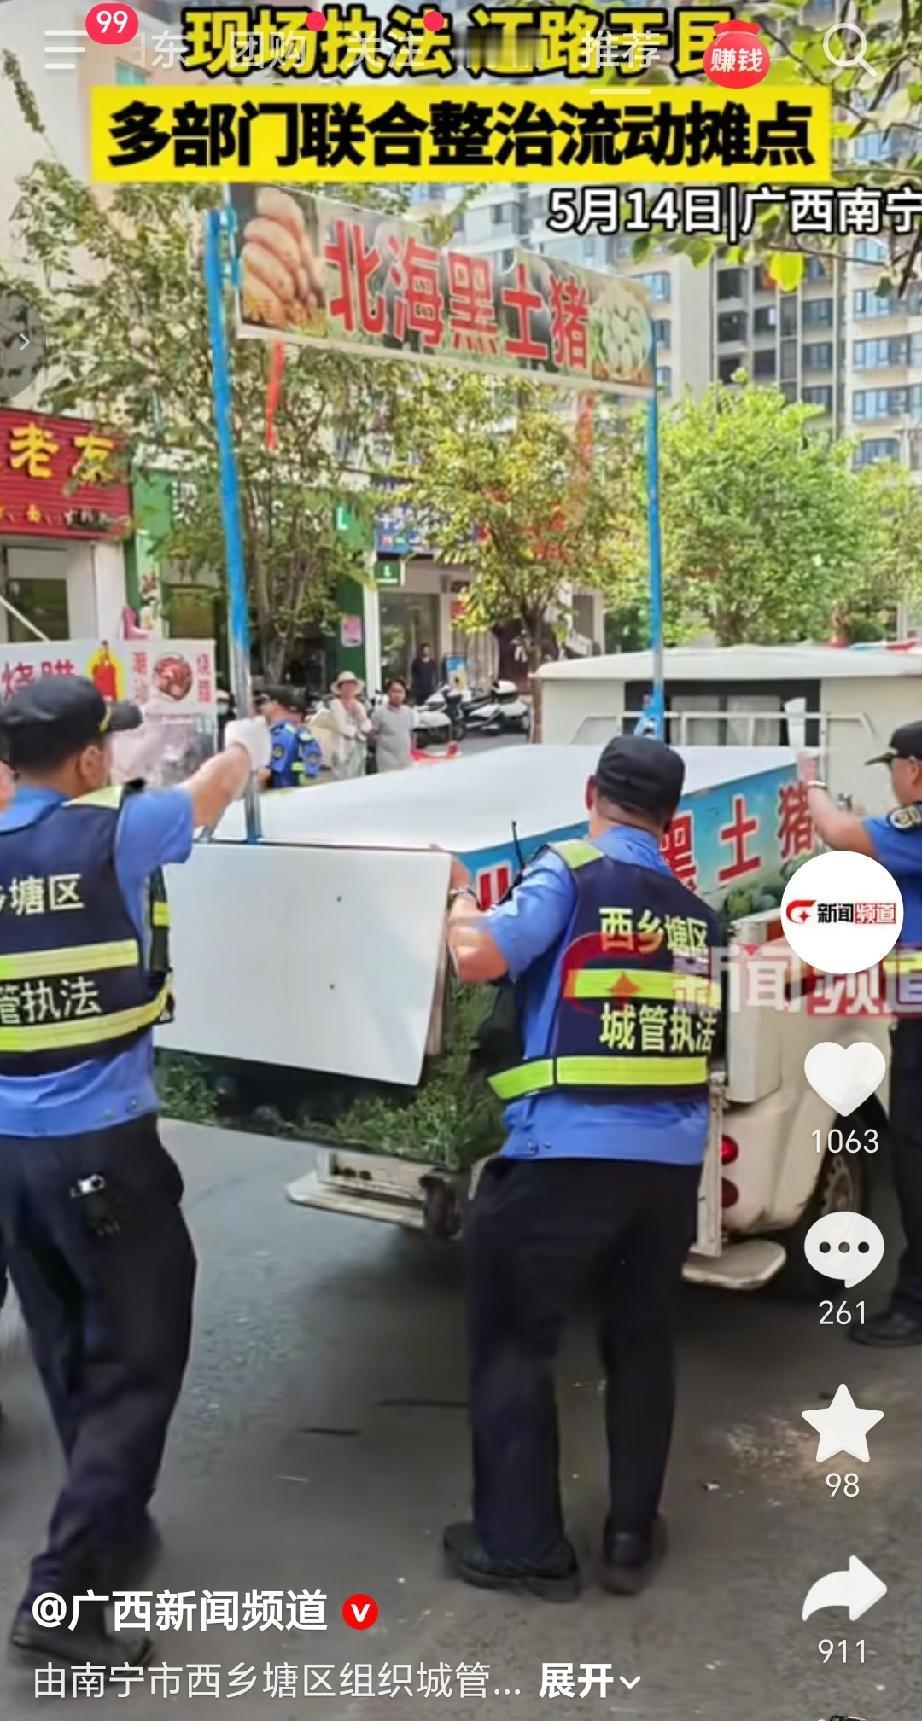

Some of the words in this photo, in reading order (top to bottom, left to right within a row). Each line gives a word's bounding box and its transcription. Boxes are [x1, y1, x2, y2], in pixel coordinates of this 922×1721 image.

[324, 217, 589, 370] 北海黑土猪
[0, 873, 85, 916] 塘区
[598, 908, 710, 958] 西乡塘区
[598, 1002, 718, 1053] 城管执法
